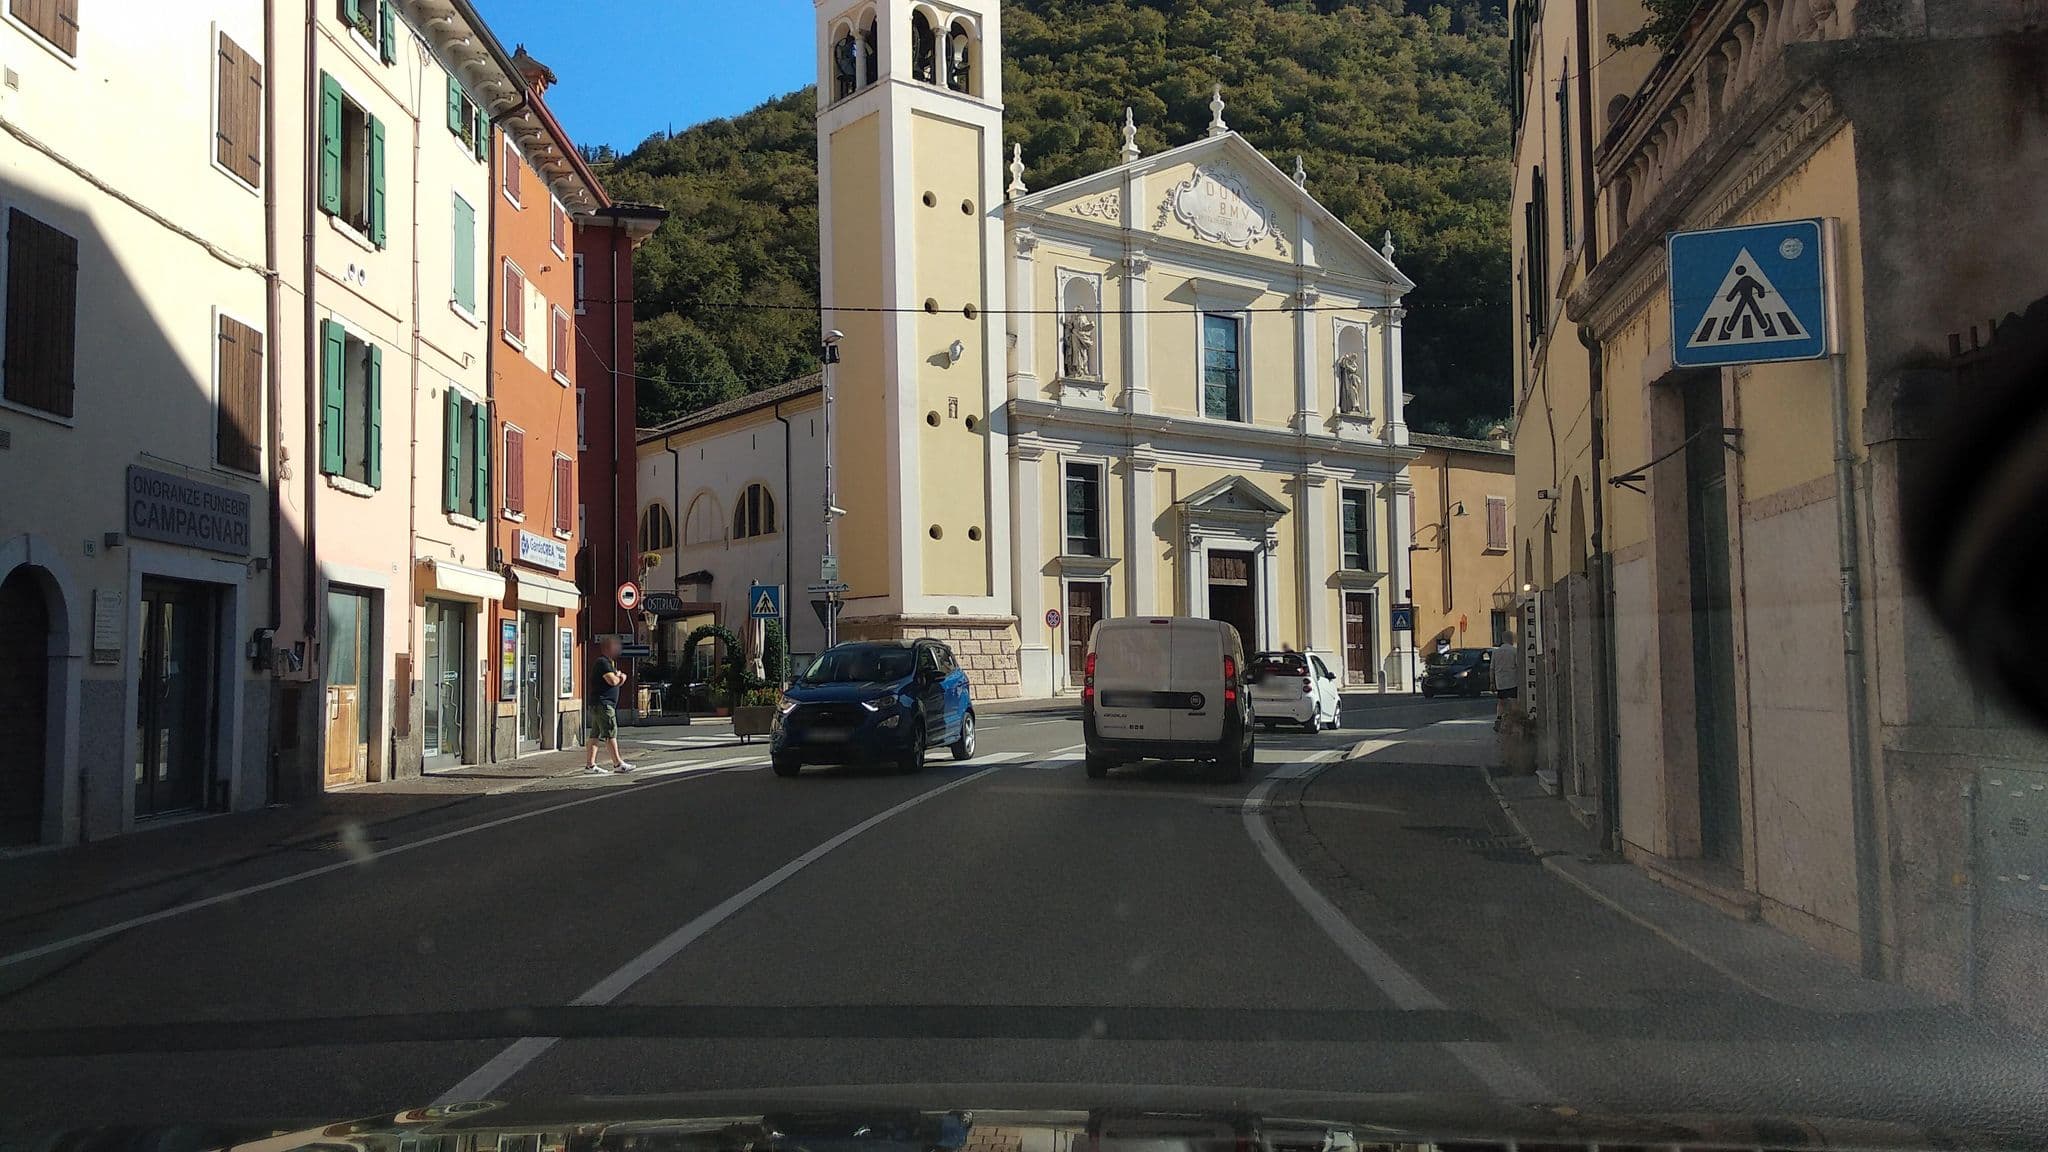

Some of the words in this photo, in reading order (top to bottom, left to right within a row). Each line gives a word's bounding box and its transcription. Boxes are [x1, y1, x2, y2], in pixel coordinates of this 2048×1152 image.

[133, 475, 200, 506] ONORANZE
[203, 492, 248, 519] FUNEBRI
[133, 500, 248, 547] CAMPAGNARI
[1526, 605, 1537, 715] GELATERIA
